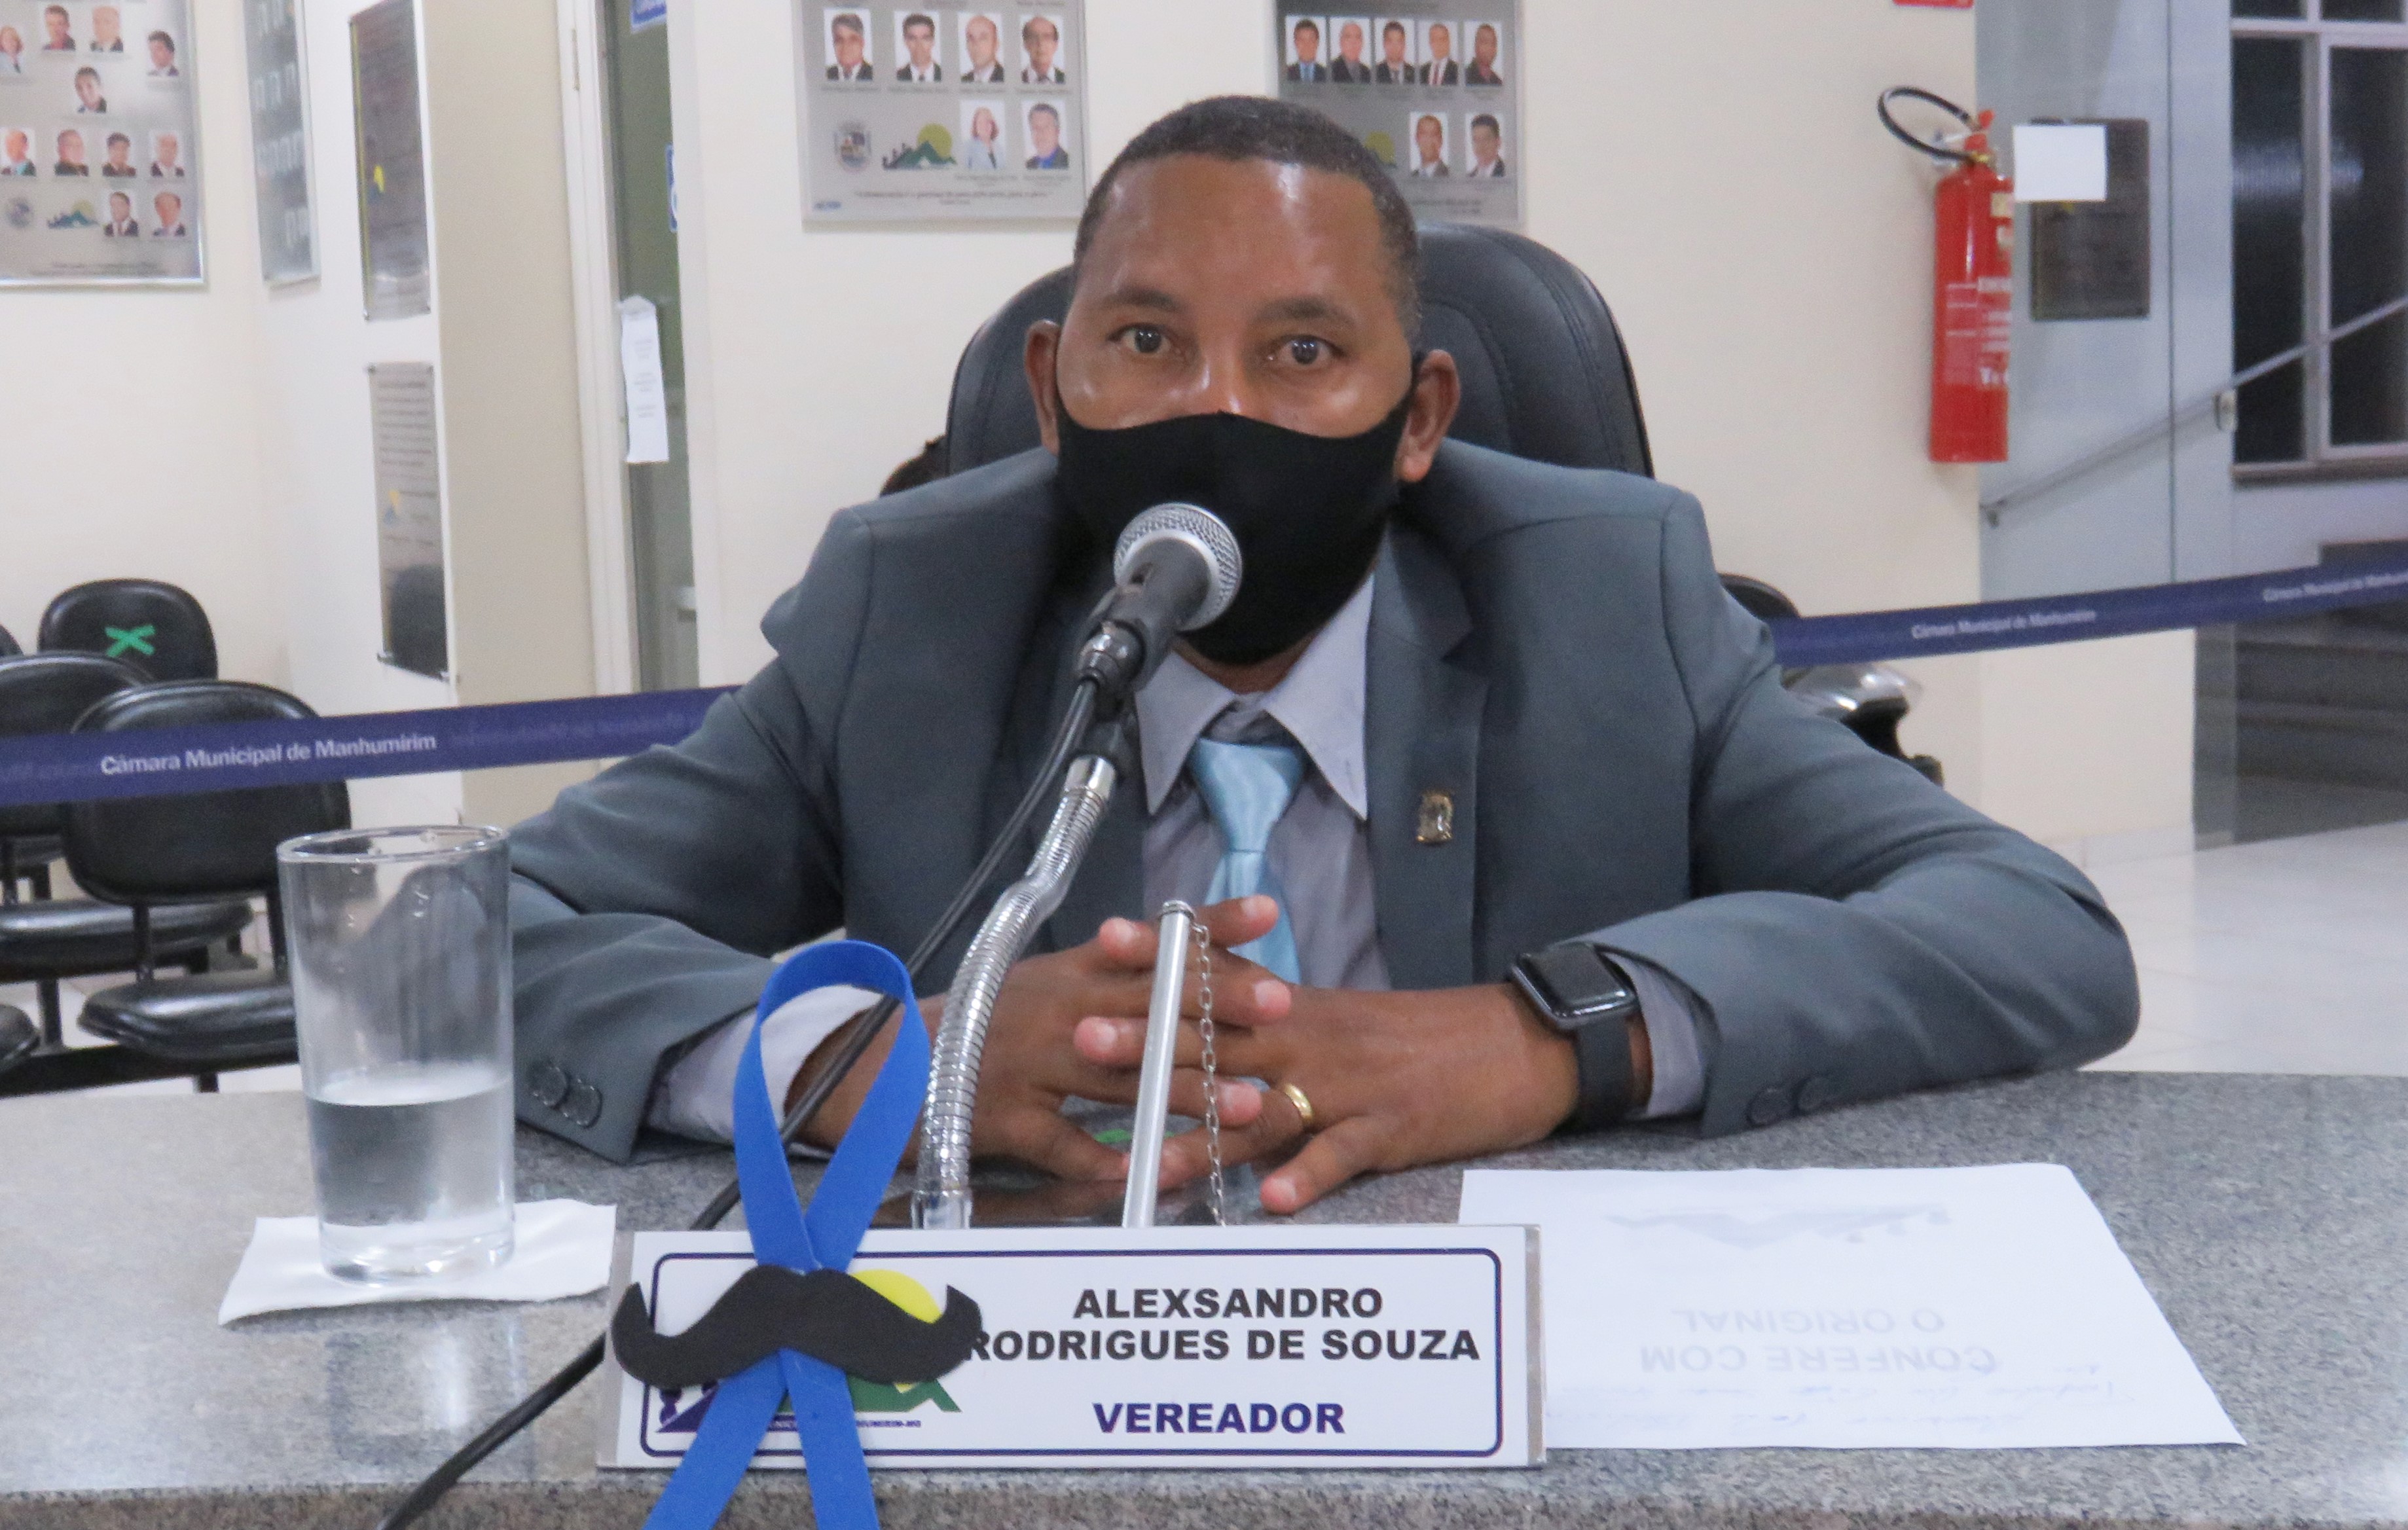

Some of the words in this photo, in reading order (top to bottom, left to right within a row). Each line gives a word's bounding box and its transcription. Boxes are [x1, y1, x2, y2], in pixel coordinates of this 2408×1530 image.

[100, 754, 181, 776] Câmara
[185, 744, 282, 769] Municipal
[286, 742, 310, 760] de
[315, 734, 437, 757] Manhumirim
[1074, 1288, 1383, 1318] ALEXSANDRO
[1672, 1309, 1896, 1334] ORIGINAL
[1910, 1309, 1944, 1334] O
[1247, 1330, 1305, 1360] DE
[1322, 1330, 1480, 1360] SOUZA
[1640, 1345, 1747, 1372] COM
[1768, 1345, 2001, 1373] CONFERE
[1093, 1402, 1345, 1434] VEREADOR
